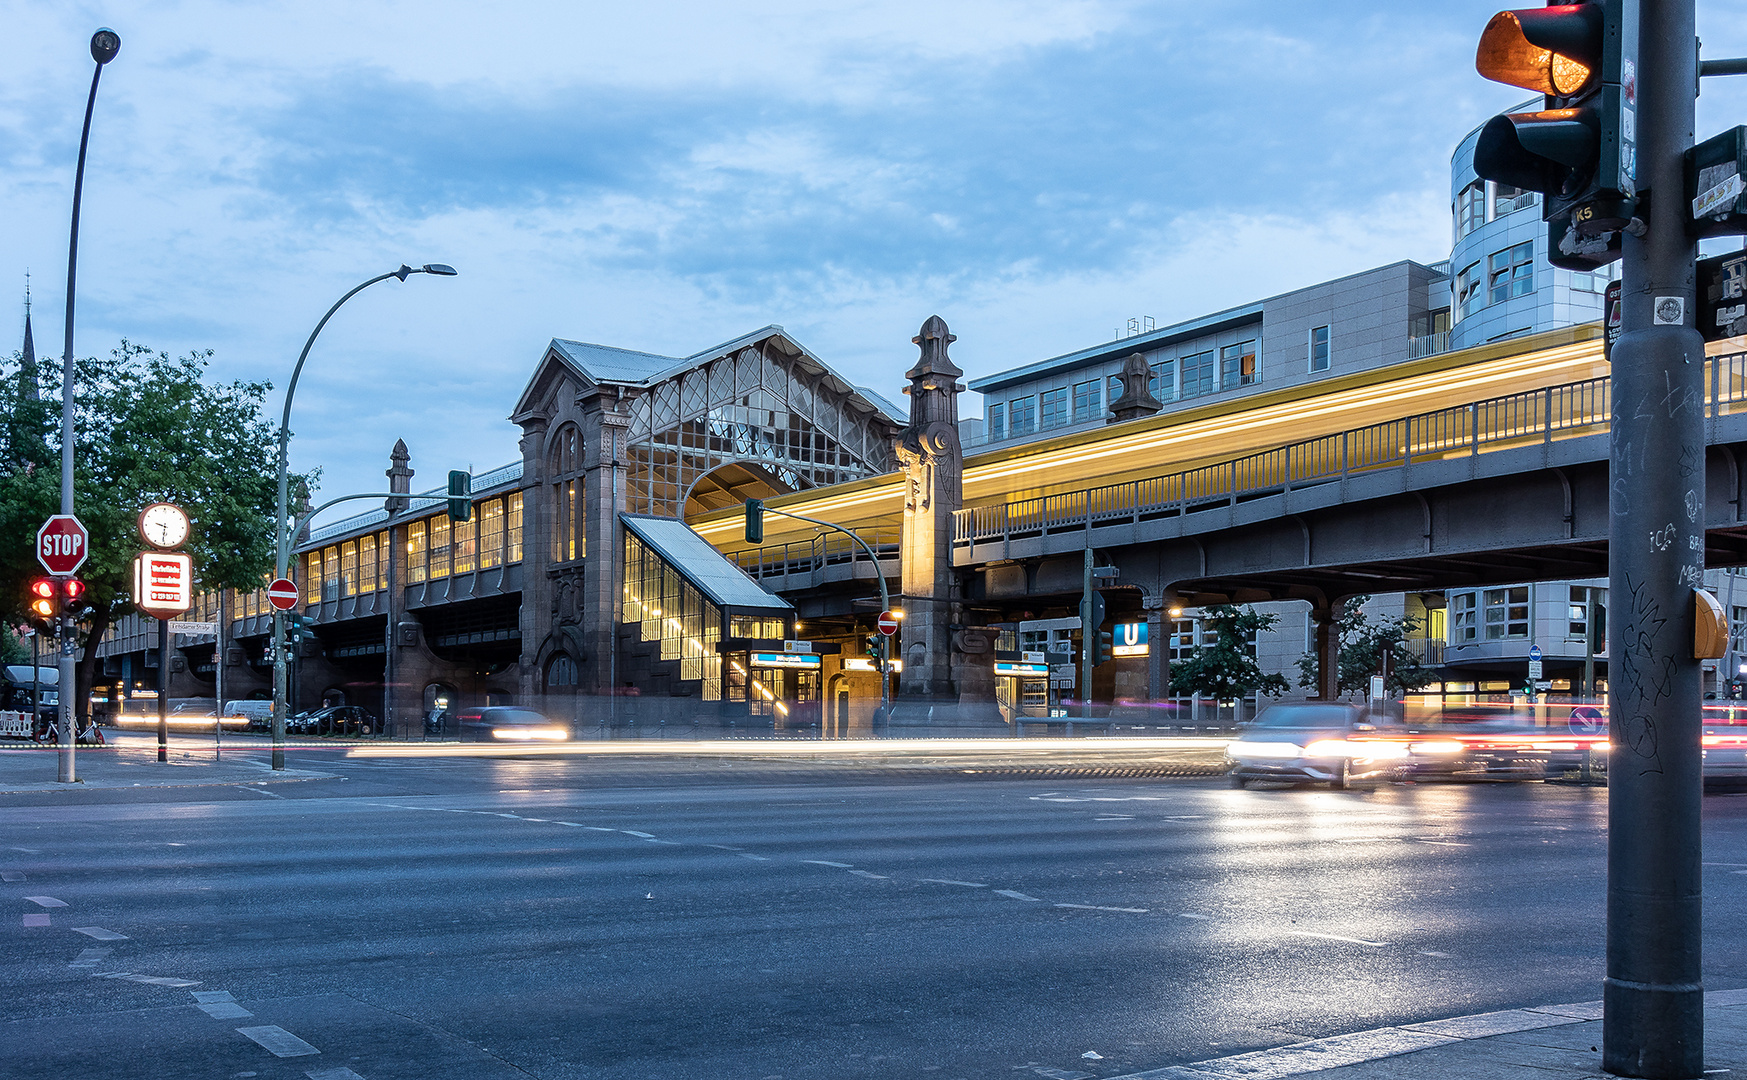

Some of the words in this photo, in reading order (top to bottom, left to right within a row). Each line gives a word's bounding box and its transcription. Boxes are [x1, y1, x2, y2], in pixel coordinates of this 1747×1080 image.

[1576, 207, 1593, 222] K5
[43, 534, 82, 556] STOP
[1124, 623, 1139, 646] U
